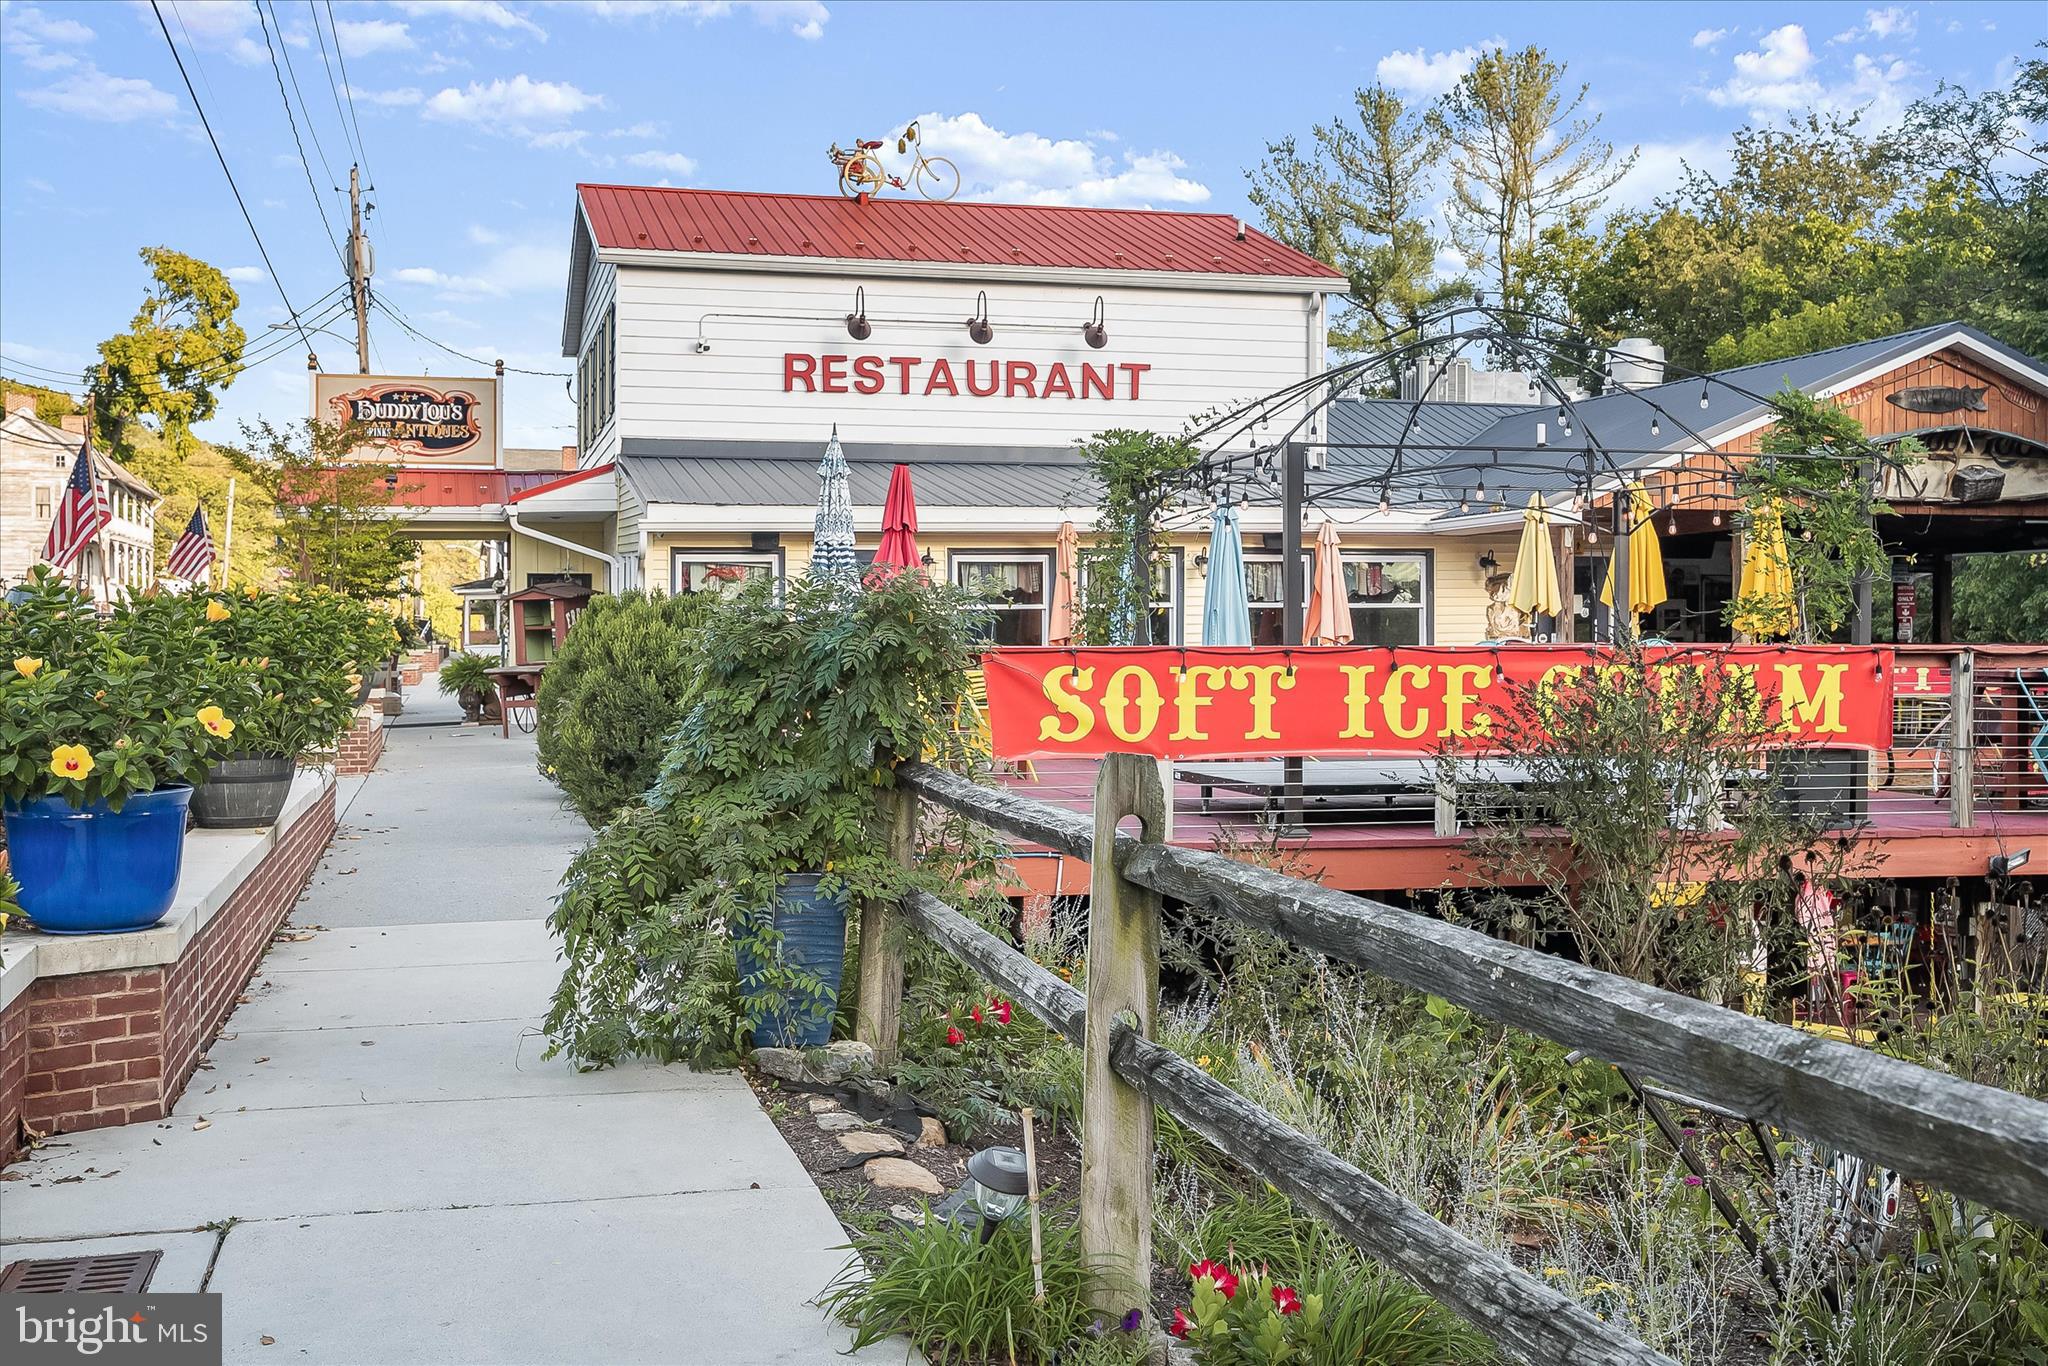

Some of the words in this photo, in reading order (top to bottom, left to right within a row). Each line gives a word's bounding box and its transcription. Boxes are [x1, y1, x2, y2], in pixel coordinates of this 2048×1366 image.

[783, 353, 1151, 400] RESTAURANT
[356, 400, 423, 421] BUDDY
[421, 402, 463, 424] LOU'S
[394, 421, 470, 439] ANTIQUES
[1037, 664, 1299, 743] SOFT
[1338, 664, 1493, 738] ICE
